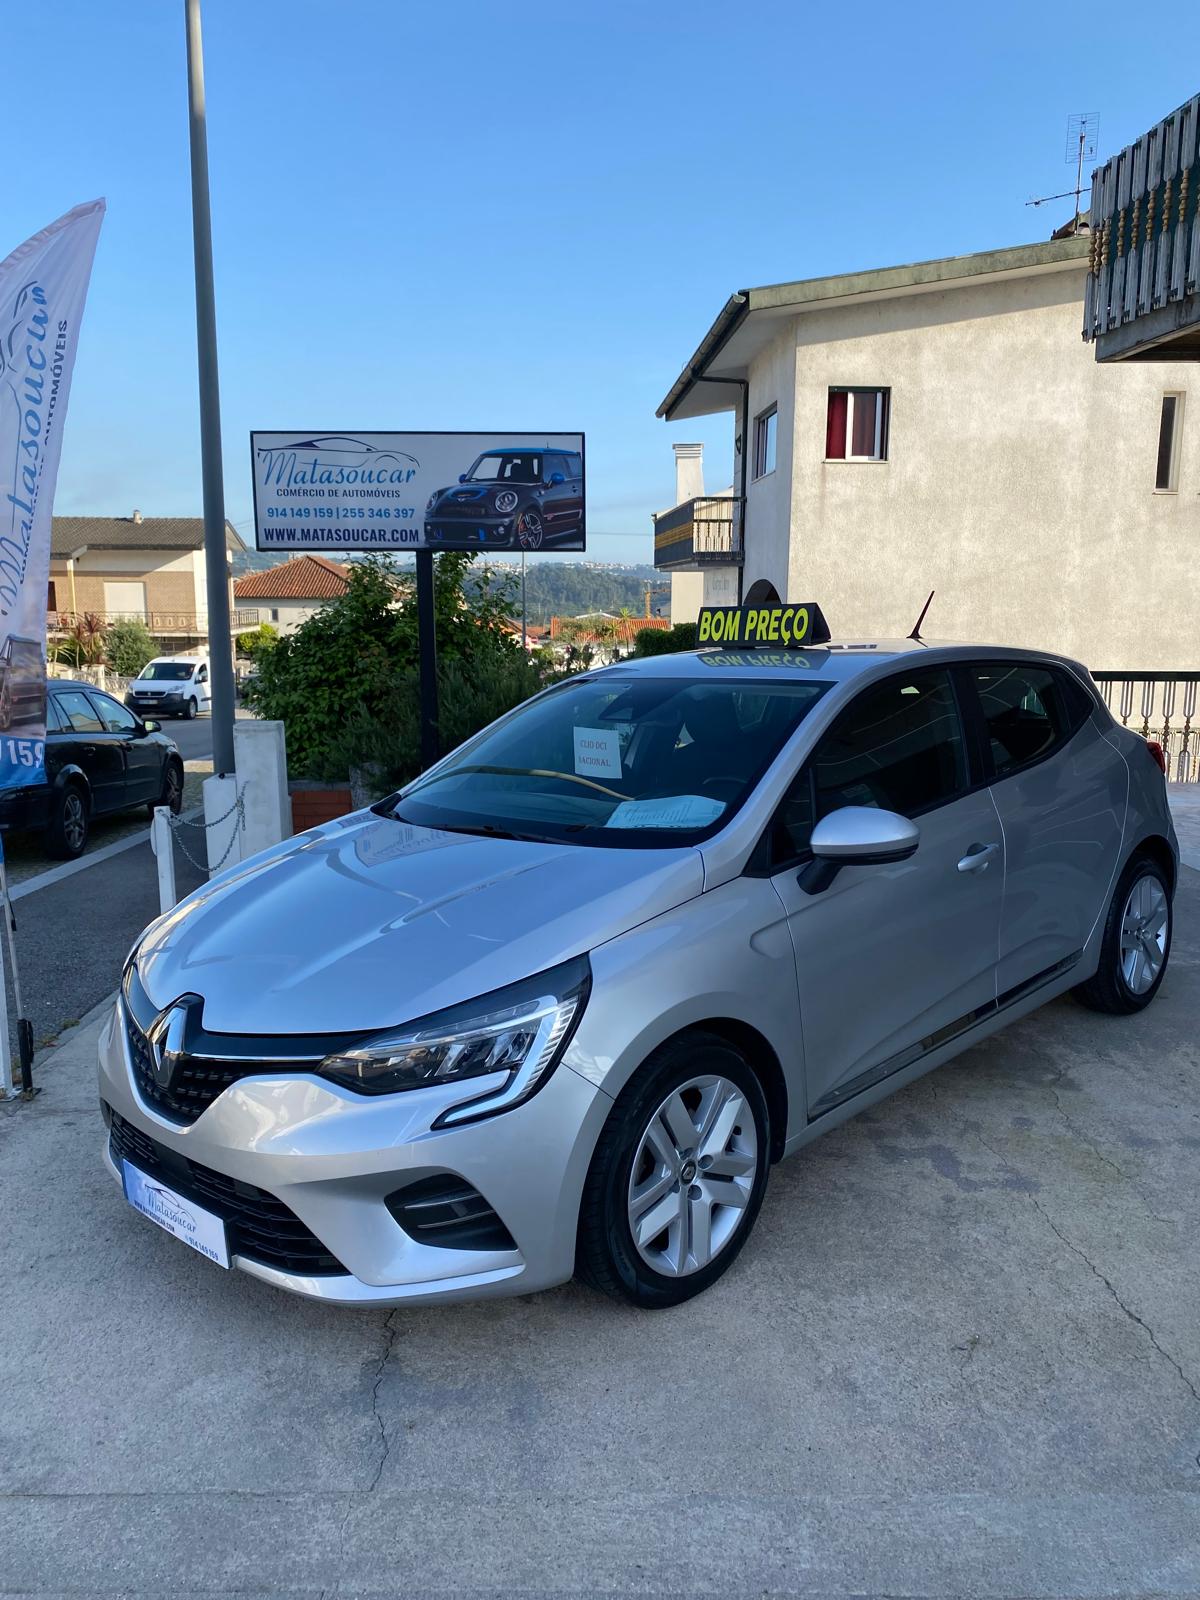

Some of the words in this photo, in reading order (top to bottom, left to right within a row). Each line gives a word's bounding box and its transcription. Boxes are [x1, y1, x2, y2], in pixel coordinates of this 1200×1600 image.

[263, 451, 416, 488] Matasoucar
[276, 486, 325, 497] COMÉRCIO
[328, 489, 339, 498] DE
[342, 487, 401, 498] AUTOMÓVEIS
[267, 507, 288, 518] 914
[291, 507, 311, 518] 149
[314, 508, 333, 518] 159
[342, 508, 365, 518] 255
[368, 508, 391, 518] 346
[394, 508, 416, 519] 397
[264, 528, 419, 543] WWW.MATASOUCAR.COM
[699, 610, 742, 642] BOM
[744, 607, 809, 646] PREÇO
